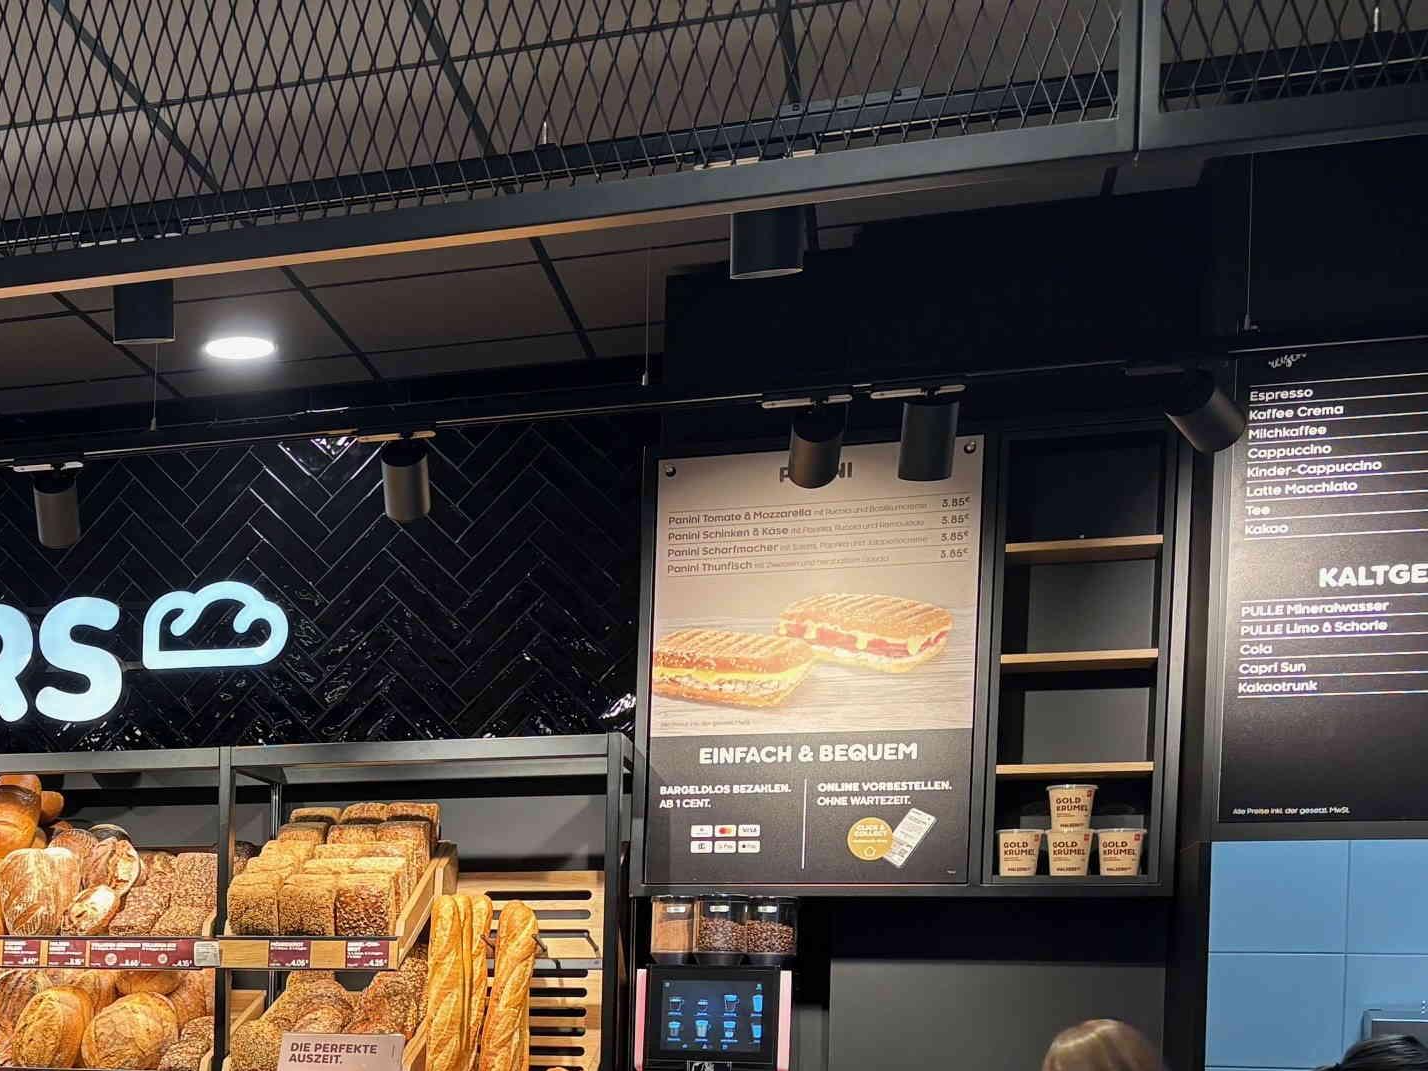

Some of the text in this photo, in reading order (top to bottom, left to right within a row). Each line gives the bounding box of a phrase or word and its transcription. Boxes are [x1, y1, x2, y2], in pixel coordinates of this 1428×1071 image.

[1250, 387, 1314, 402] Espresso
[1249, 405, 1344, 421] Kaffee Crema
[1248, 425, 1327, 440] Milchkaffee
[1248, 444, 1332, 460] Cappuccino
[1247, 460, 1382, 478] Kinder-Cappuccino
[1246, 481, 1358, 497] Latte Macchiato
[668, 515, 700, 525] Panini
[702, 514, 742, 523] Tomate
[753, 508, 812, 520] Mozzarella
[1245, 505, 1270, 516] Tee
[668, 531, 700, 541] Panini
[702, 528, 750, 539] Schinken
[1245, 523, 1289, 535] Kakao
[667, 547, 700, 558] Panini
[702, 544, 779, 556] Scharfmacher
[667, 563, 699, 574] Panini
[702, 561, 753, 572] Thunfisch
[1241, 601, 1389, 617] PULLE Mineralwasser
[1241, 624, 1283, 636] PULLE
[1286, 622, 1320, 634] Limo
[1334, 620, 1388, 632] Schorle
[1240, 643, 1272, 655] Cola
[1239, 662, 1307, 676] Capri Sun
[1238, 680, 1318, 693] Kakaotrunk
[699, 743, 917, 764] EINFACH & BEQUEM
[659, 784, 792, 795] BARGELDLOS BEZAHLEN.
[817, 781, 952, 792] ONLINE VORBESTELLEN.
[659, 799, 711, 808] AB 1 CENT.
[817, 796, 911, 806] OHNE WARTEZEIT.
[290, 1042, 378, 1054] DIE PERFEKTE
[289, 1054, 343, 1064] AUSZEIT.
